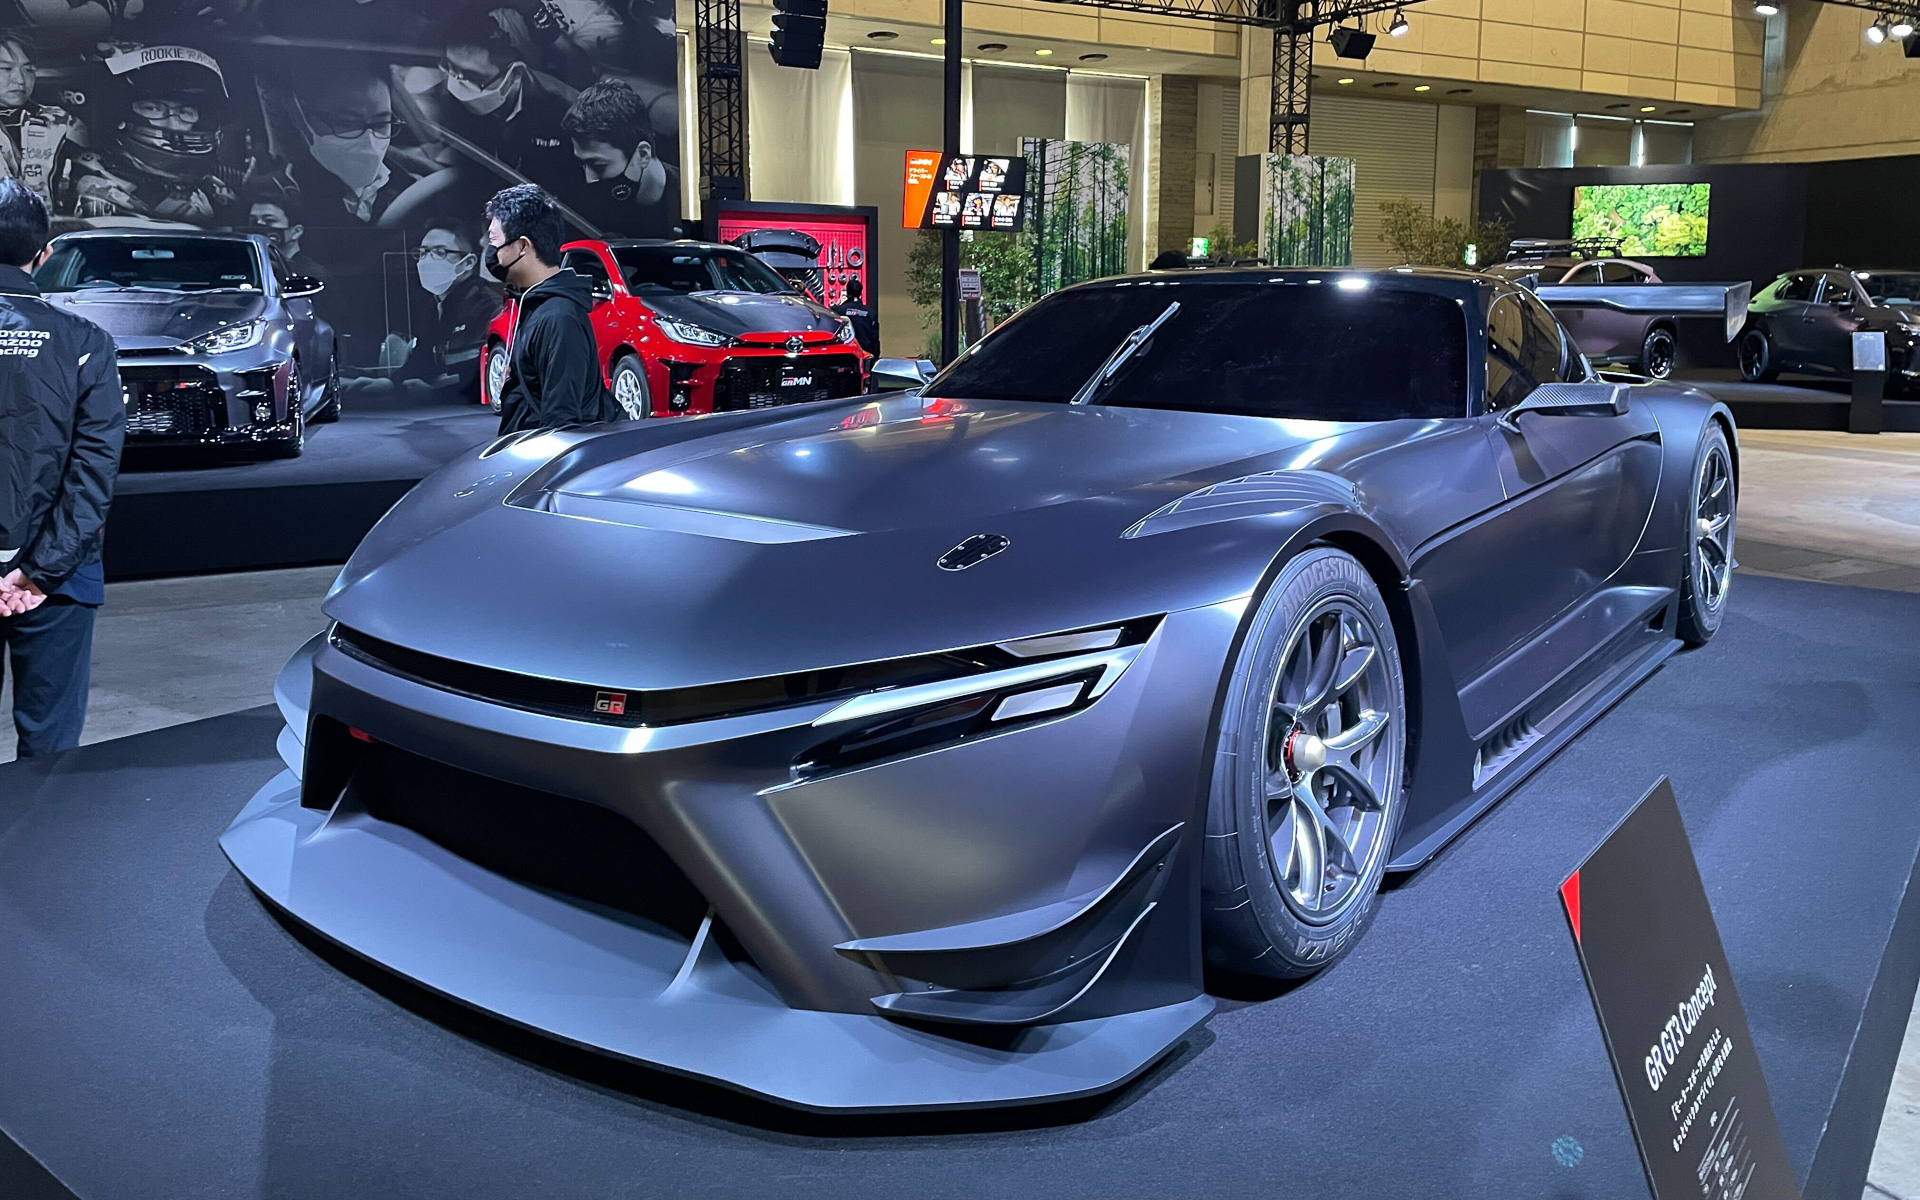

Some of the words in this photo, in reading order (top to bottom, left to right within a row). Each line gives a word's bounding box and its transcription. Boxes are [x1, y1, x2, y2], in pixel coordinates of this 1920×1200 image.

[141, 48, 184, 63] ROOKIE
[0, 329, 51, 340] OYOTA
[0, 338, 43, 347] AZOO
[1278, 556, 1369, 628] BRIDGESTONE
[1645, 1045, 1668, 1091] GR
[1661, 1014, 1685, 1066] GT3
[1679, 963, 1717, 1035] Concept
